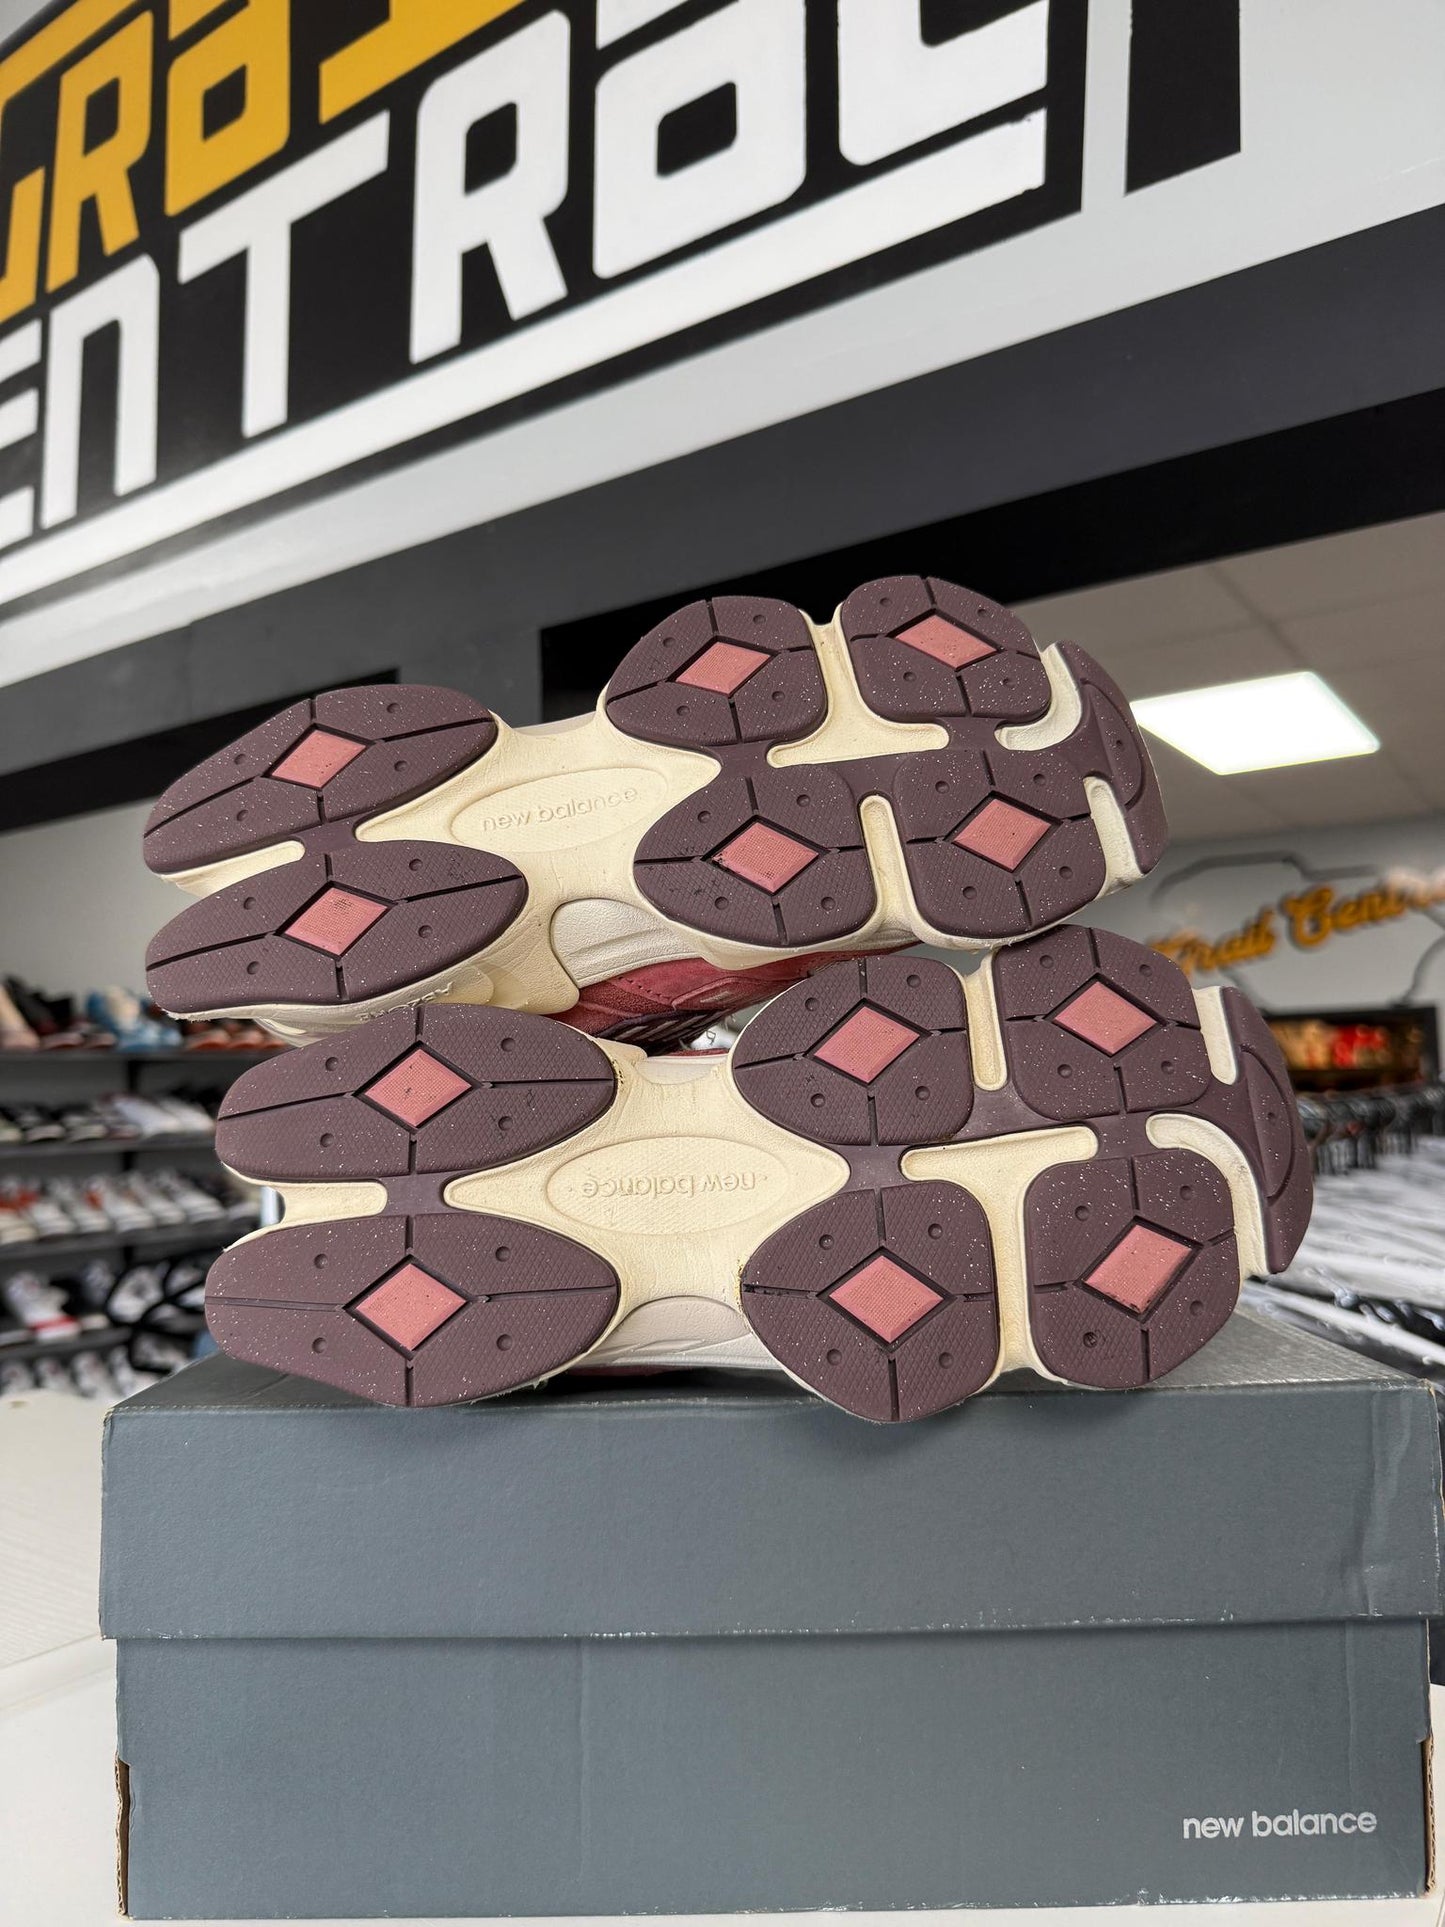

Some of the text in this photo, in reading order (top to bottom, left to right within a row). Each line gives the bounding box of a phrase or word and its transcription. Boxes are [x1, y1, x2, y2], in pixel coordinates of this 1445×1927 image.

[480, 785, 639, 833] new balance
[582, 1171, 757, 1199] new balance
[1183, 1809, 1378, 1839] new balance
